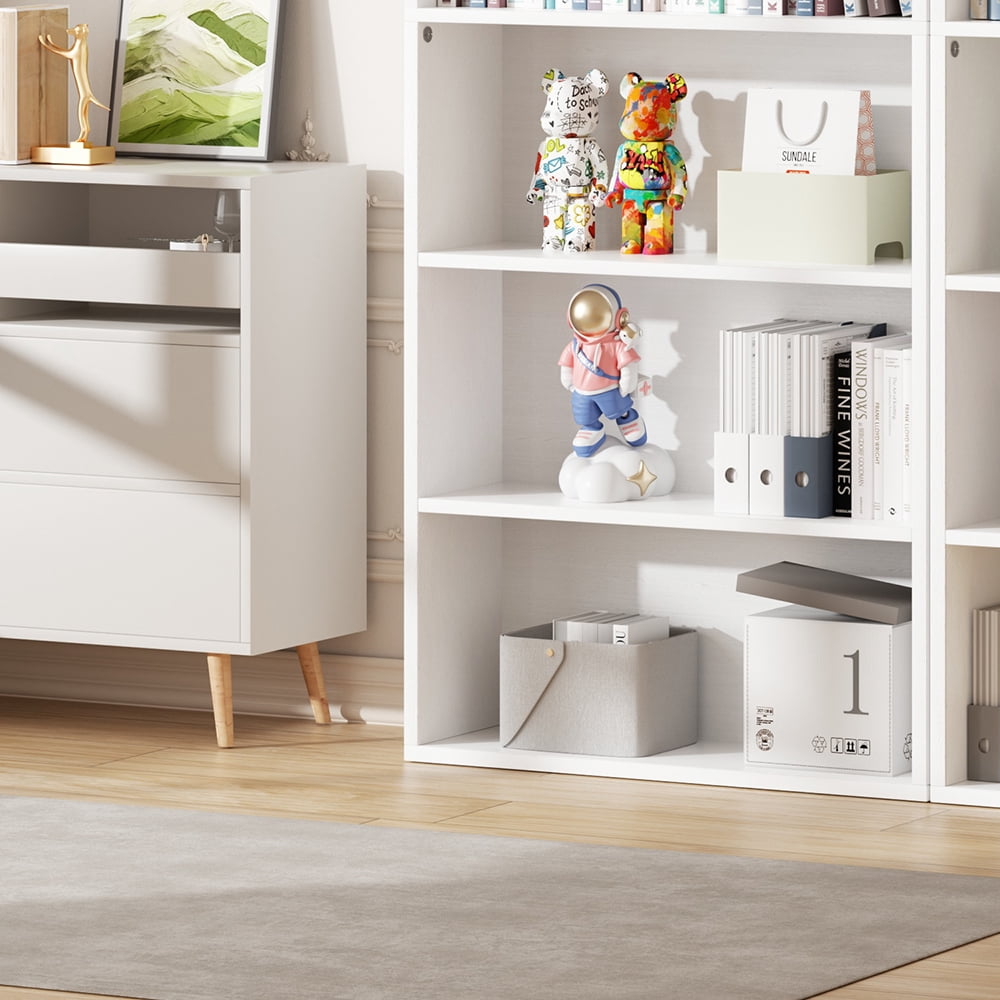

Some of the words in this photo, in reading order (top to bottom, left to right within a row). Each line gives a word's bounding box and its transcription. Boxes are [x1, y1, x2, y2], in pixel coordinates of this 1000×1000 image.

[565, 96, 578, 109] to
[781, 150, 817, 163] SUNDALE
[837, 376, 851, 421] FINE
[855, 348, 868, 420] WINDOWS
[837, 429, 851, 496] WINES
[843, 648, 869, 716] 1
